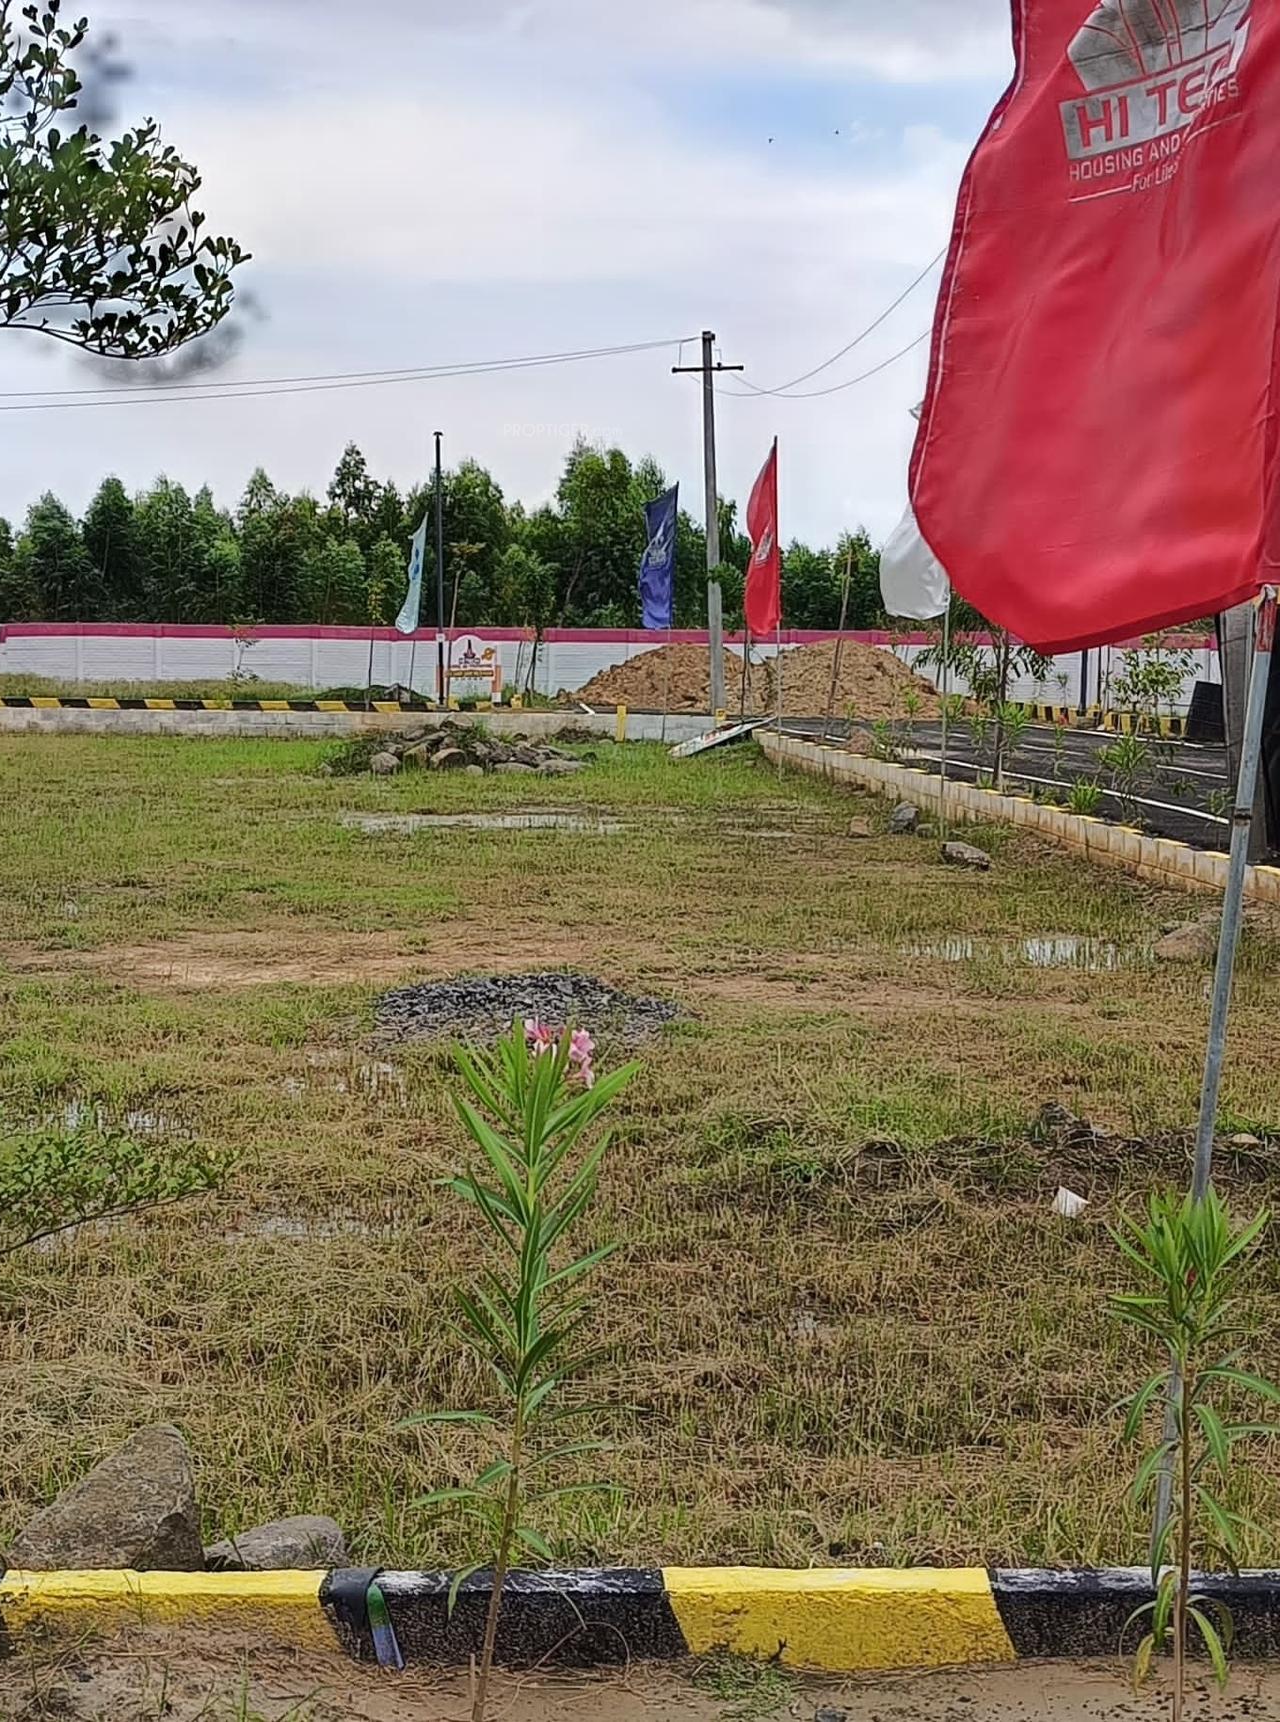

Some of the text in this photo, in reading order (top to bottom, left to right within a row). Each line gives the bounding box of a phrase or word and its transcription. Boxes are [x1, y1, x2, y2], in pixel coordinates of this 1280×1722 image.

[1076, 96, 1128, 150] HI
[1069, 147, 1143, 181] HOUSING
[1149, 133, 1180, 162] AND
